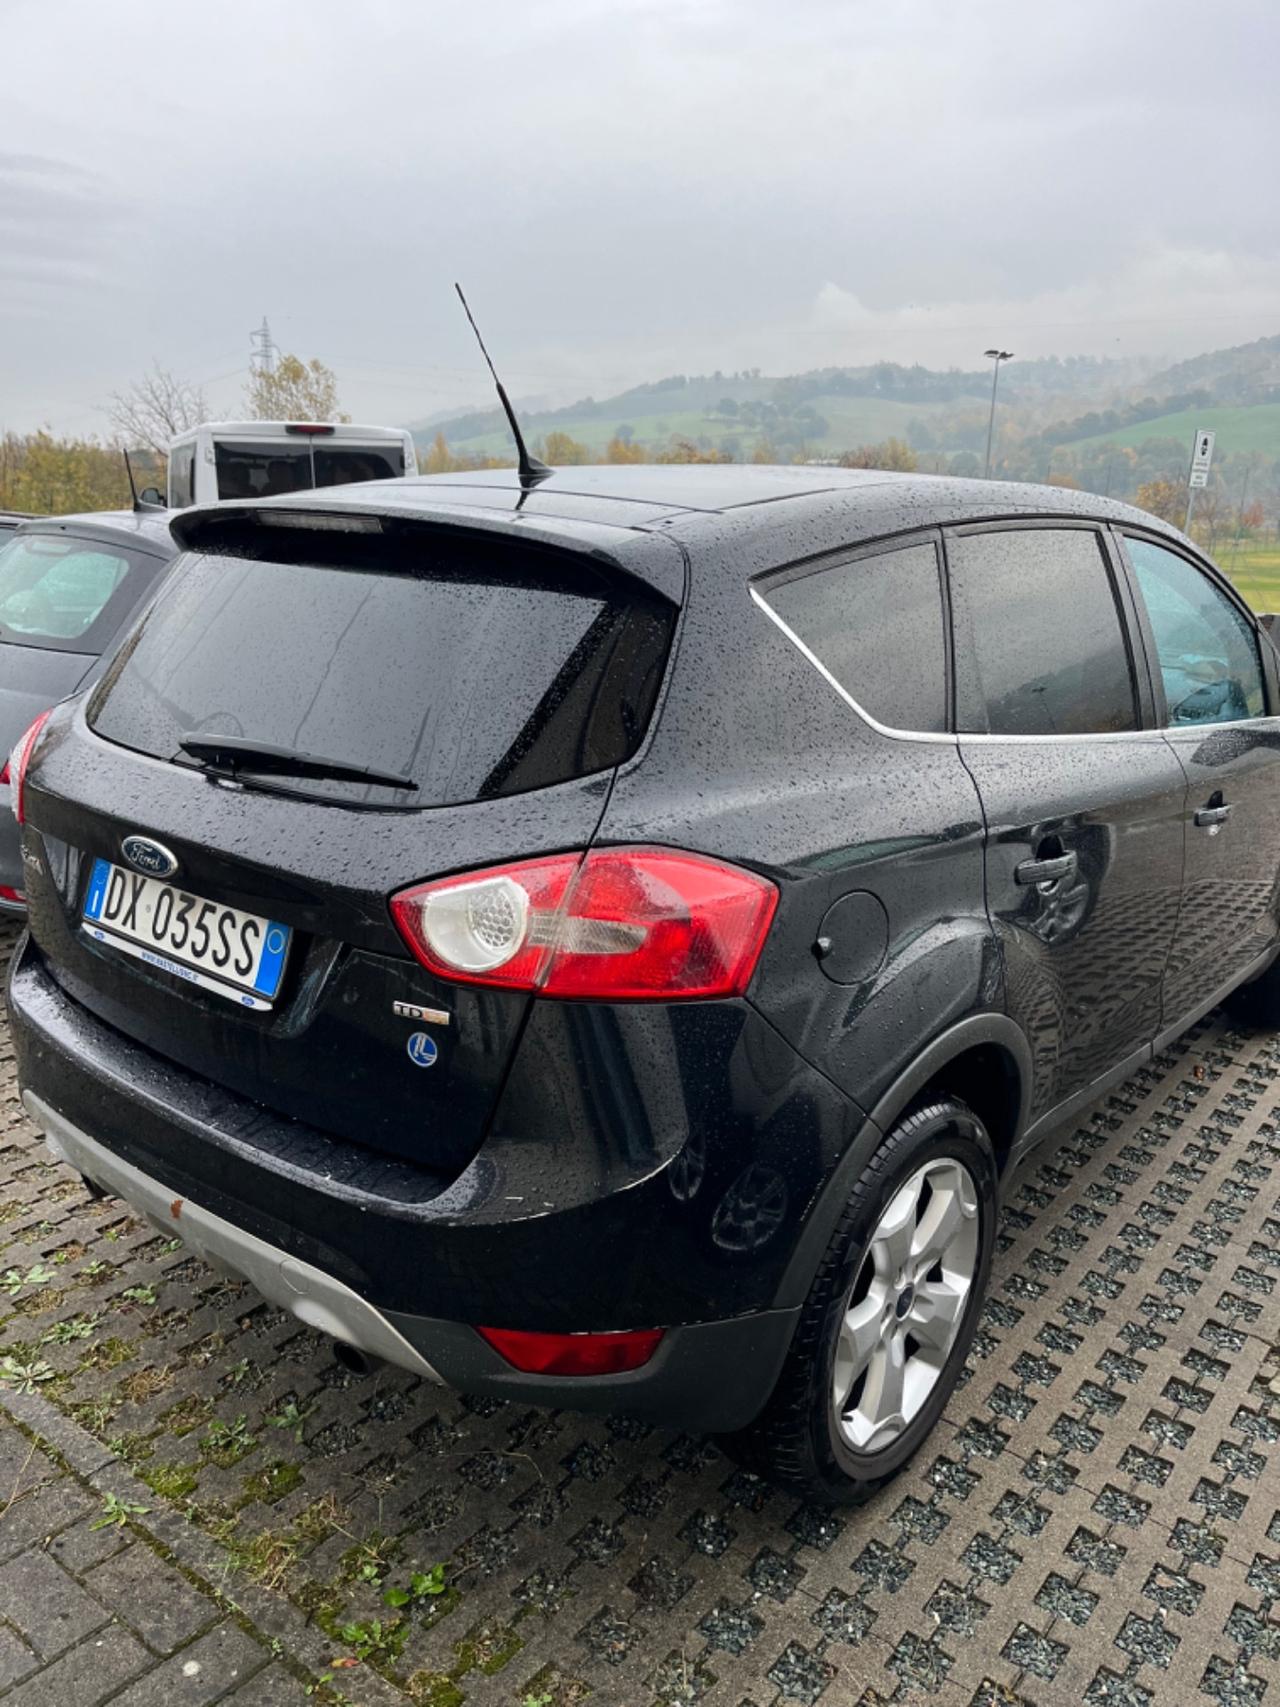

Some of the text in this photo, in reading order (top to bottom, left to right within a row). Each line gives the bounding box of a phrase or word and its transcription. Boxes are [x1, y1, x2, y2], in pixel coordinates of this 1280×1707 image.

[130, 843, 161, 870] Ford
[103, 868, 147, 931] DX
[152, 887, 260, 976] 035SS
